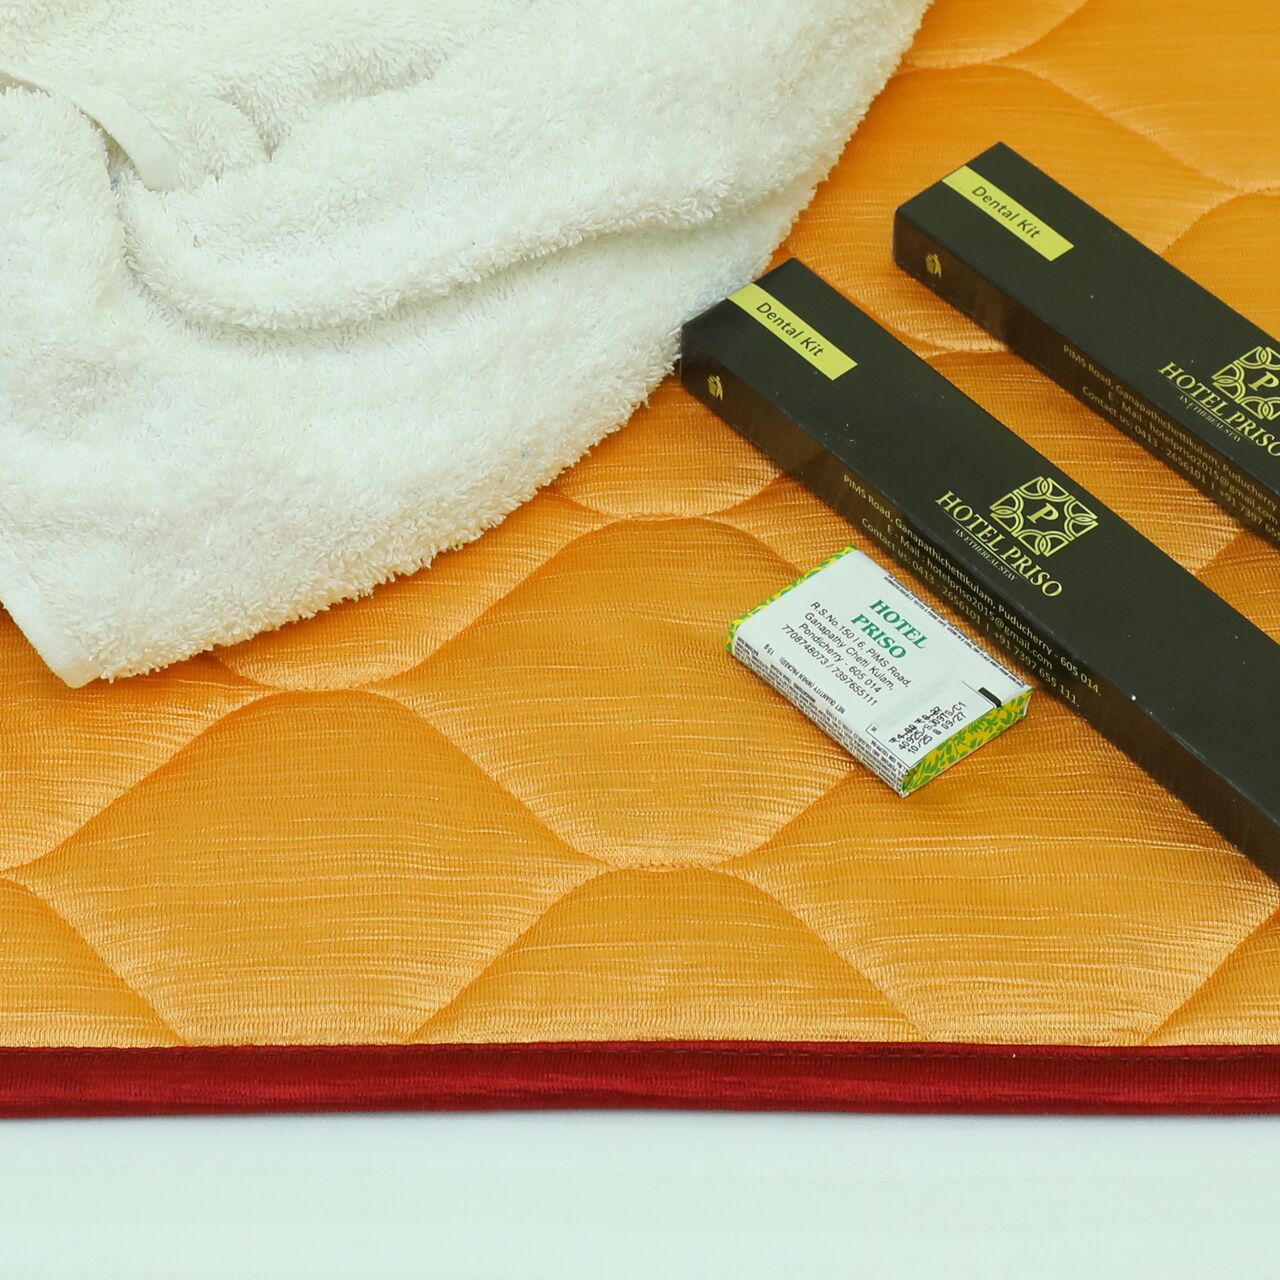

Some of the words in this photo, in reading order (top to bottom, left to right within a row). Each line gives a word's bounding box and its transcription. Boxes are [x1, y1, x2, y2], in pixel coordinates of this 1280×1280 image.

[972, 186, 1020, 221] Dental
[1017, 219, 1040, 238] Kit
[756, 302, 804, 339] Dental
[800, 337, 824, 357] Kit
[1158, 362, 1228, 416] HOTEL
[1248, 371, 1279, 391] P
[1063, 343, 1087, 368] PIMS
[1088, 363, 1113, 390] Road,
[1115, 384, 1219, 469] Ganapathichettikulam,
[1222, 463, 1278, 512] Puducherry
[1082, 385, 1117, 418] Contact
[1133, 424, 1158, 448] 0413
[1166, 448, 1206, 484] 2656101
[1240, 503, 1262, 525] 7397
[1121, 401, 1142, 423] Mail
[1149, 421, 1278, 526] hotelpriso2015@gmail.com
[1026, 502, 1059, 524] P
[935, 491, 1005, 552] HOTEL
[1000, 546, 1063, 597] PRISO
[964, 535, 999, 568] ETHEREAL
[997, 565, 1018, 581] STAY
[843, 473, 867, 499] PIMS
[868, 495, 891, 522] Road,
[895, 517, 994, 609] Ganapathichettikulam,
[997, 604, 1053, 654] Puducherry
[1059, 655, 1080, 676] 605
[1079, 672, 1101, 696] 014.
[886, 523, 893, 535] E
[899, 534, 921, 558] Mail
[927, 557, 1053, 670] hotelpriso2015@gmail.com
[850, 614, 906, 659] PRISO
[860, 517, 895, 551] Contact
[896, 548, 909, 563] us:
[911, 559, 934, 585] 0413
[942, 587, 982, 625] 2656101
[993, 630, 1011, 650] +91
[1013, 646, 1037, 670] 7397
[1038, 667, 1058, 688] 655
[1059, 684, 1078, 708] 111.
[869, 600, 928, 649] HOTEL
[780, 623, 829, 666] 7708748073
[831, 667, 878, 707] 7397655111
[798, 622, 844, 663] Pondicherry
[848, 665, 865, 680] 605
[863, 678, 881, 694] 014
[803, 611, 846, 648] Ganapathy
[844, 645, 871, 668] Chetti
[868, 665, 895, 691] Kulam,
[865, 647, 889, 668] PIMS
[886, 665, 910, 688] Road,
[812, 684, 836, 706] QUANTITY
[834, 703, 846, 714] NET
[941, 711, 967, 729] 09/27
